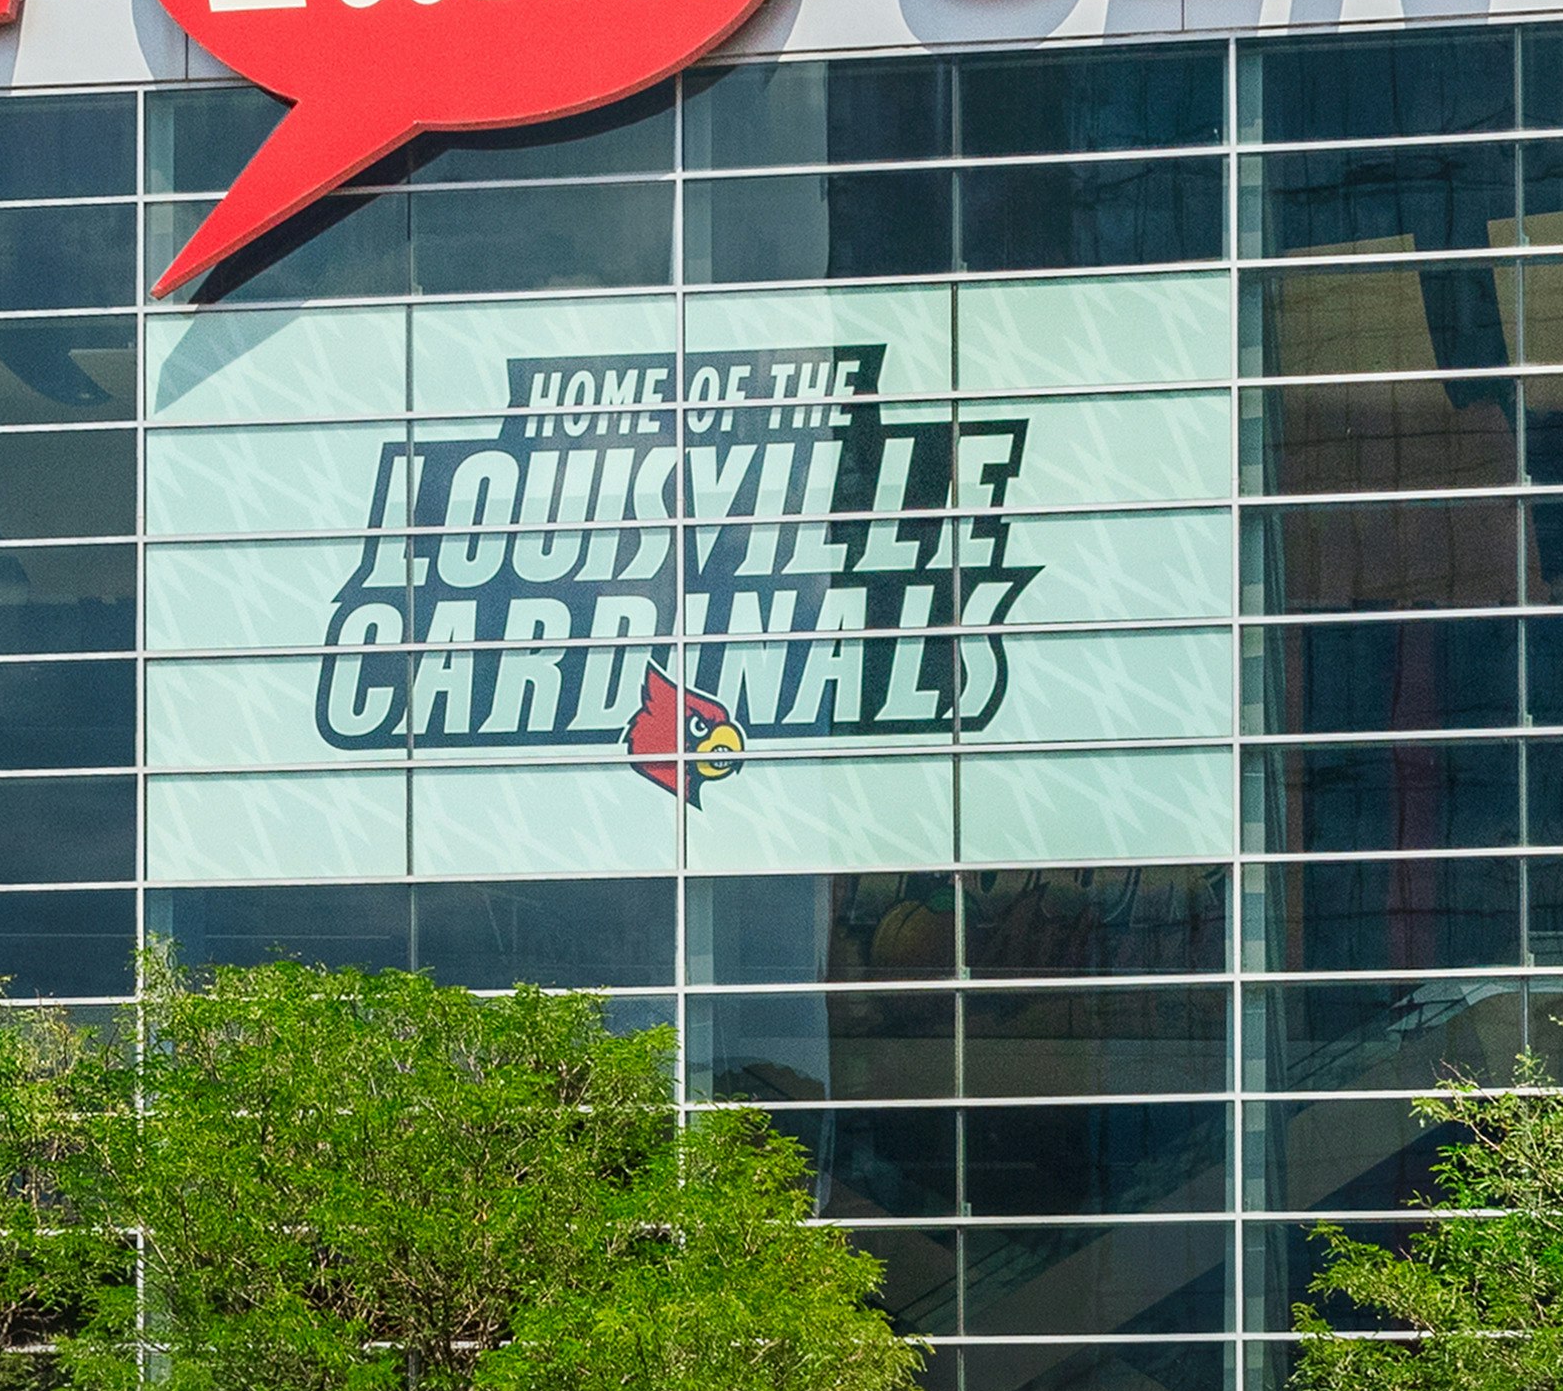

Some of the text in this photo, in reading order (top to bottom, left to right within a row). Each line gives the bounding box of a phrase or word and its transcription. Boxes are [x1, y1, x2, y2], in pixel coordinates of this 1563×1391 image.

[524, 359, 862, 439] HOME OF THE
[361, 432, 1016, 588] LOUISVILLE
[327, 580, 1016, 737] CARDINALS
